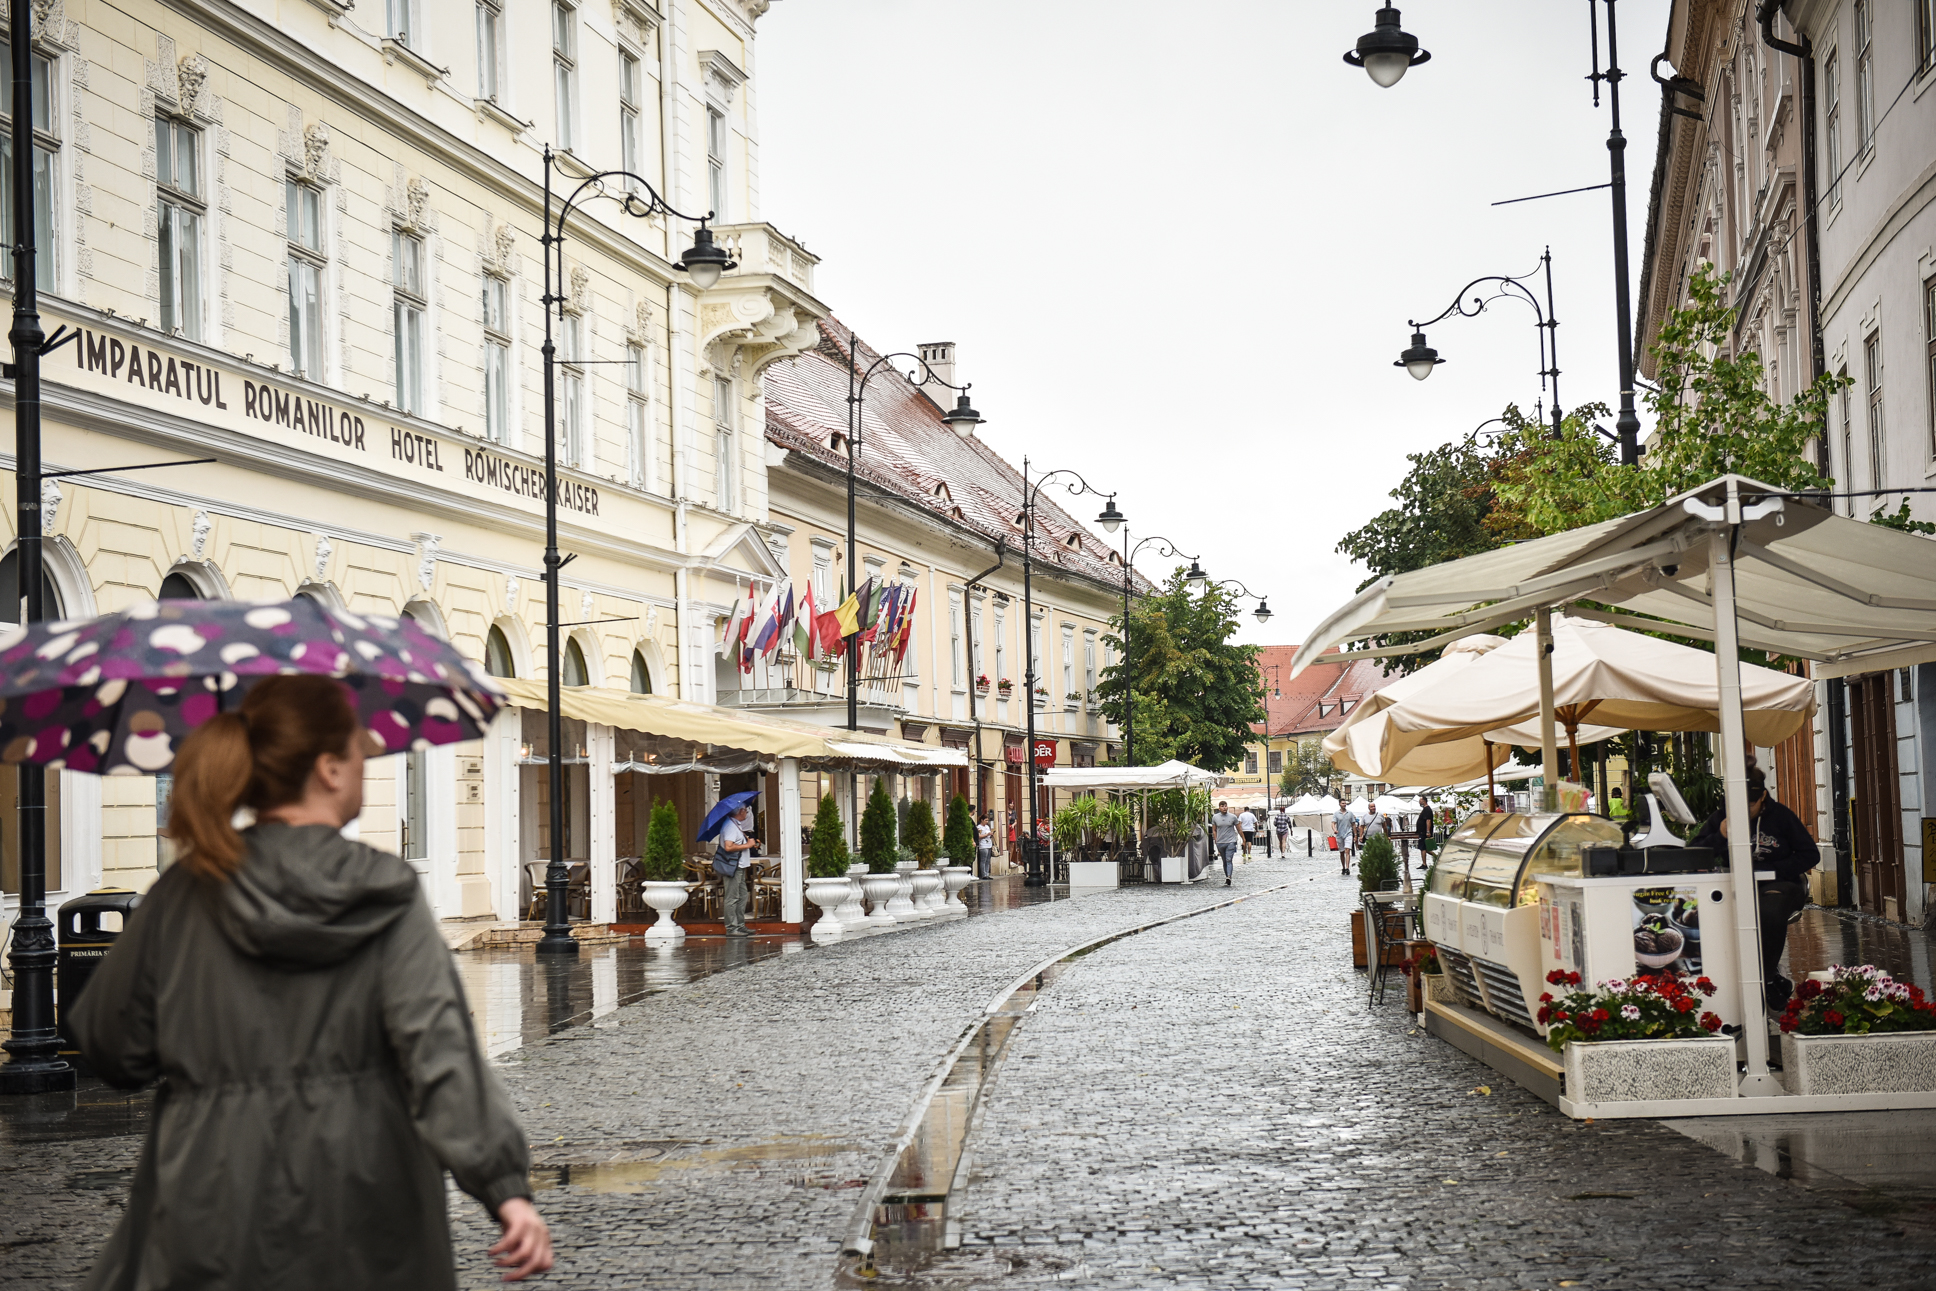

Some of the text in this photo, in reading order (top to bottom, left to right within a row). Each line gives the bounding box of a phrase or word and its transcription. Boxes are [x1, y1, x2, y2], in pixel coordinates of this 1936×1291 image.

[76, 327, 227, 411] IMPARATUL
[244, 380, 366, 451] ROMANILOR
[390, 427, 443, 472] HOTEL
